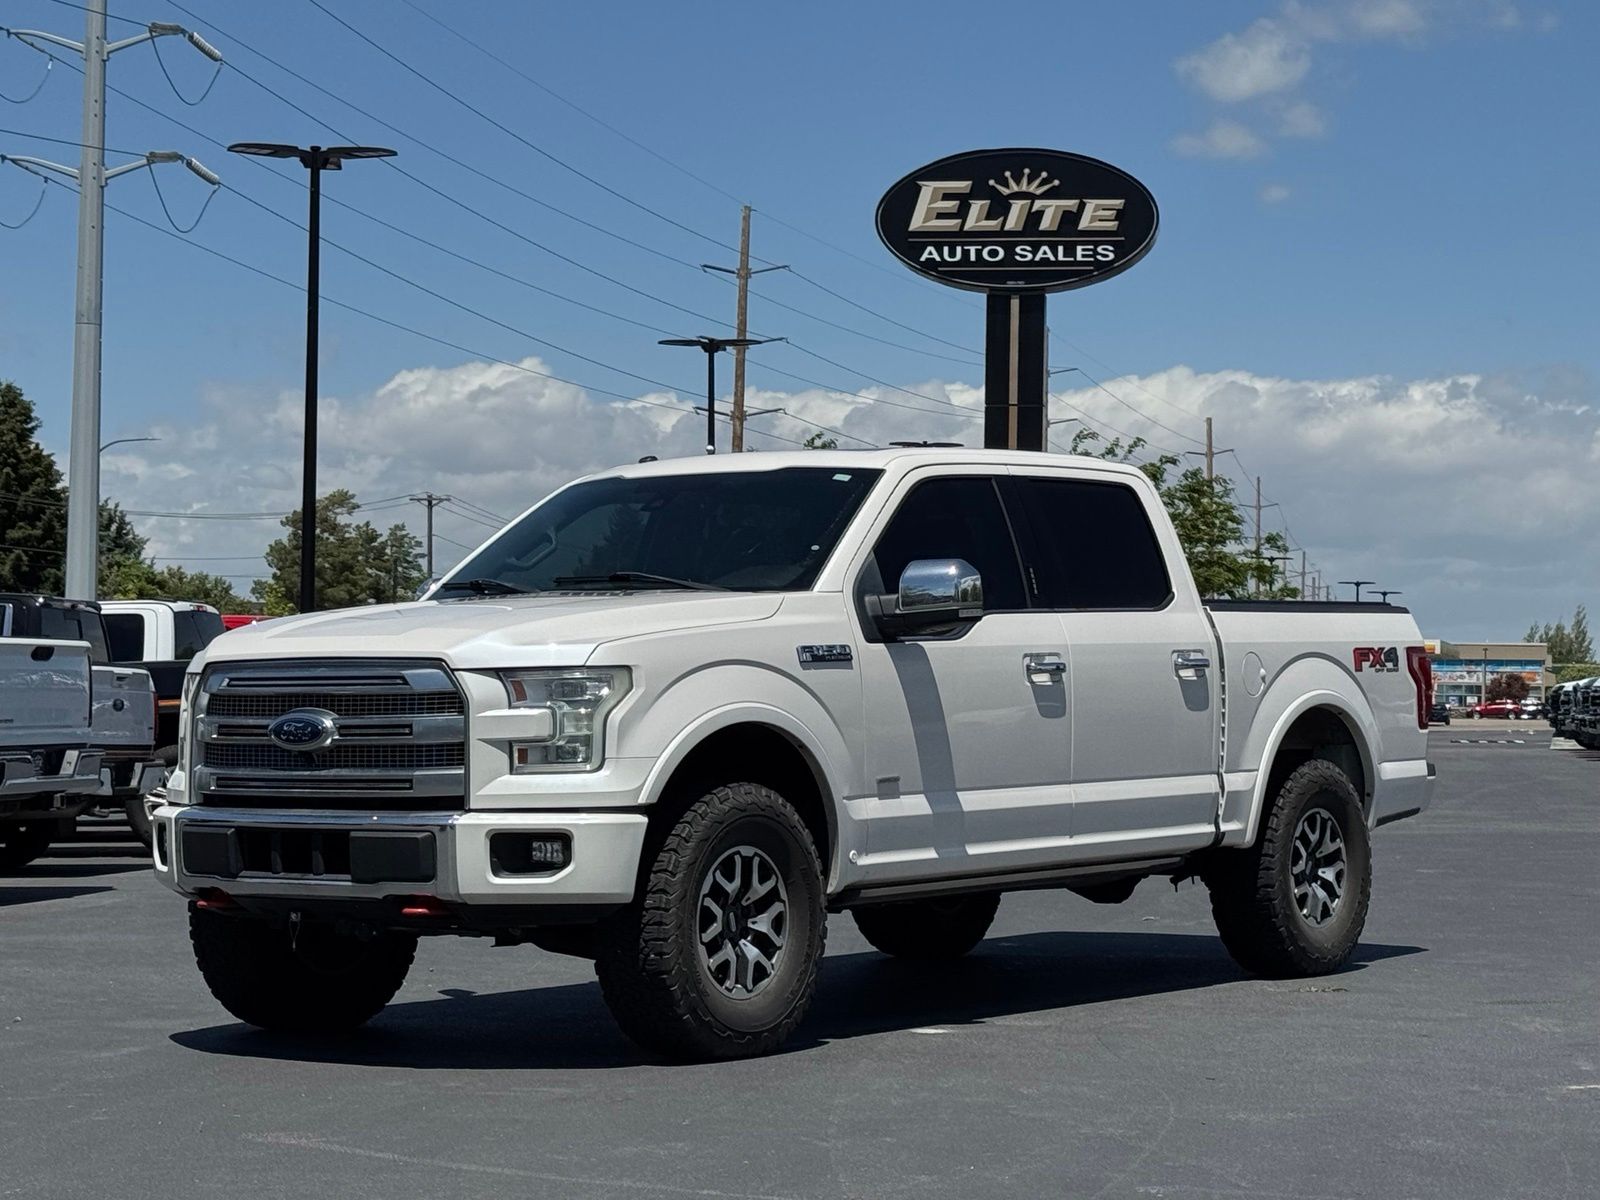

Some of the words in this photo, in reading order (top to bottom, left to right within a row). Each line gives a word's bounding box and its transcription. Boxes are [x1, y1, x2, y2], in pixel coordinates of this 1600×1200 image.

[907, 180, 1125, 232] ELITE
[919, 245, 1005, 262] AUTO
[1014, 245, 1115, 262] SALES
[1353, 646, 1399, 672] FX4
